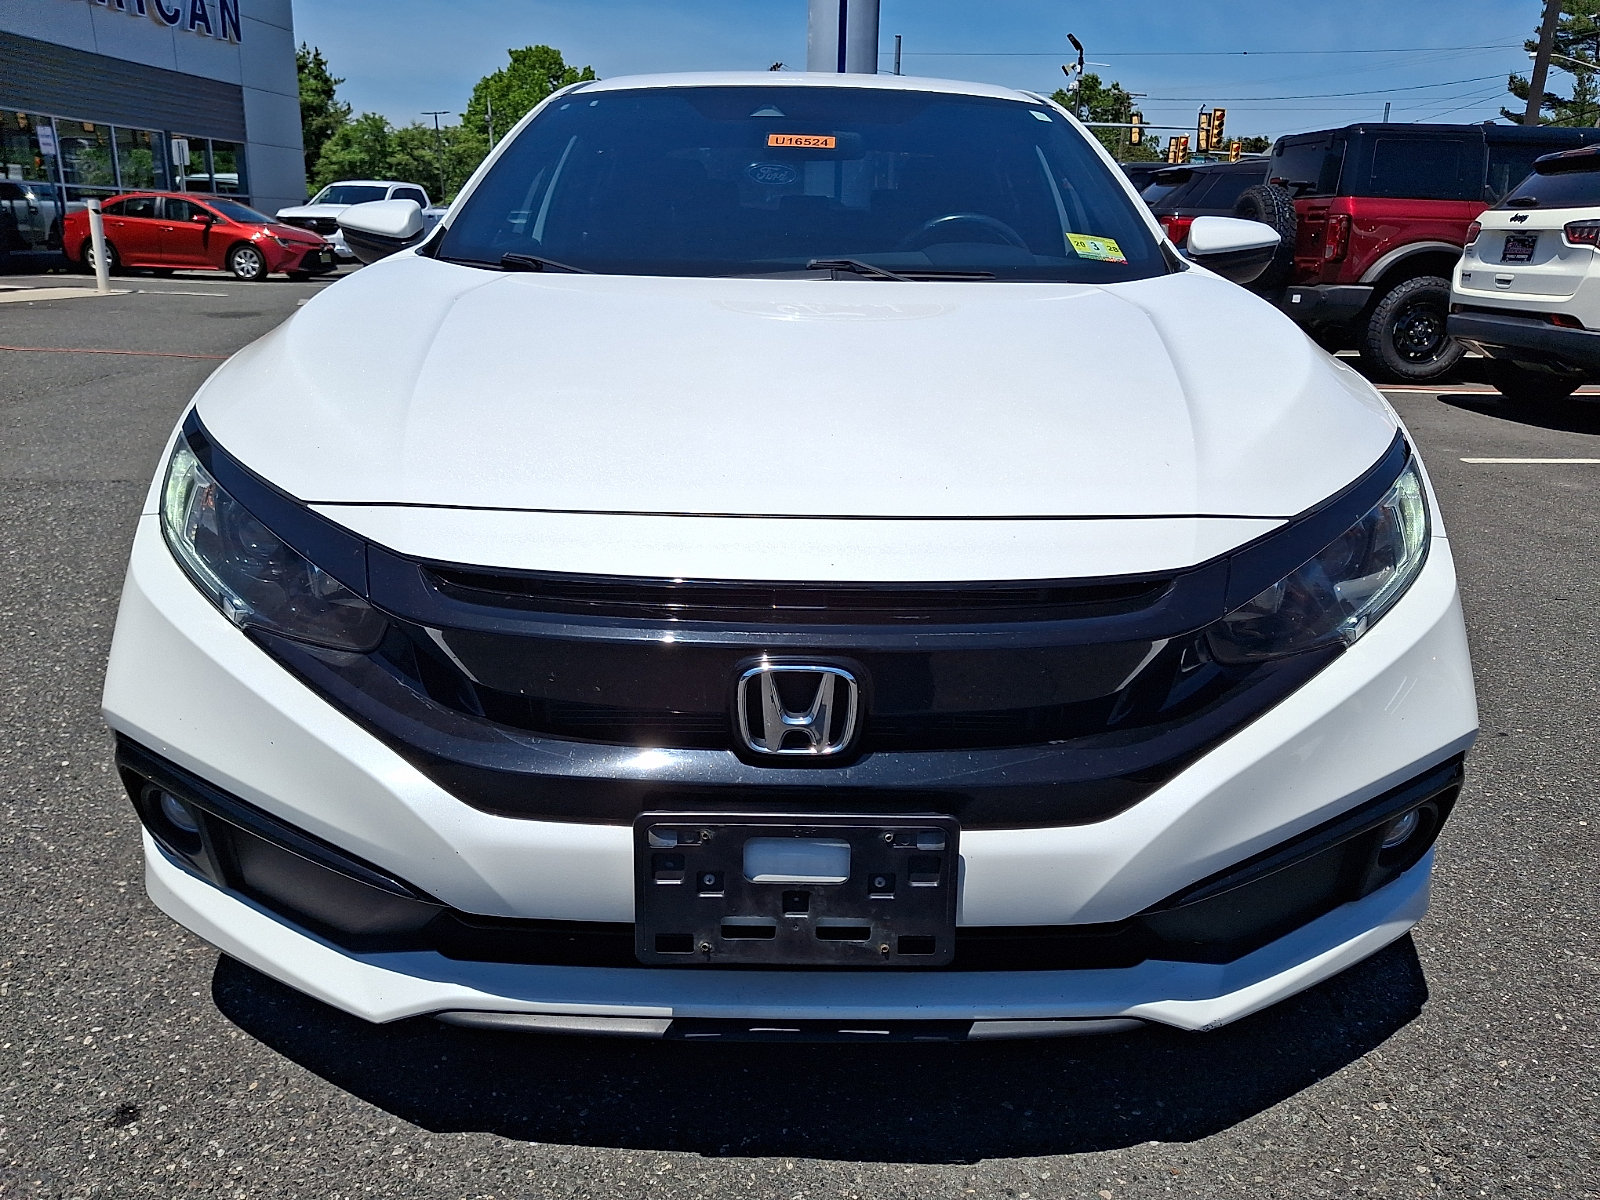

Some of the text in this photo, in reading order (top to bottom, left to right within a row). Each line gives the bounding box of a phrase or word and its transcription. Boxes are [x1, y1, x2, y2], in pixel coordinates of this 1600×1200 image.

[96, 0, 242, 43] CAN
[775, 136, 828, 147] U16524
[1090, 242, 1100, 251] 3
